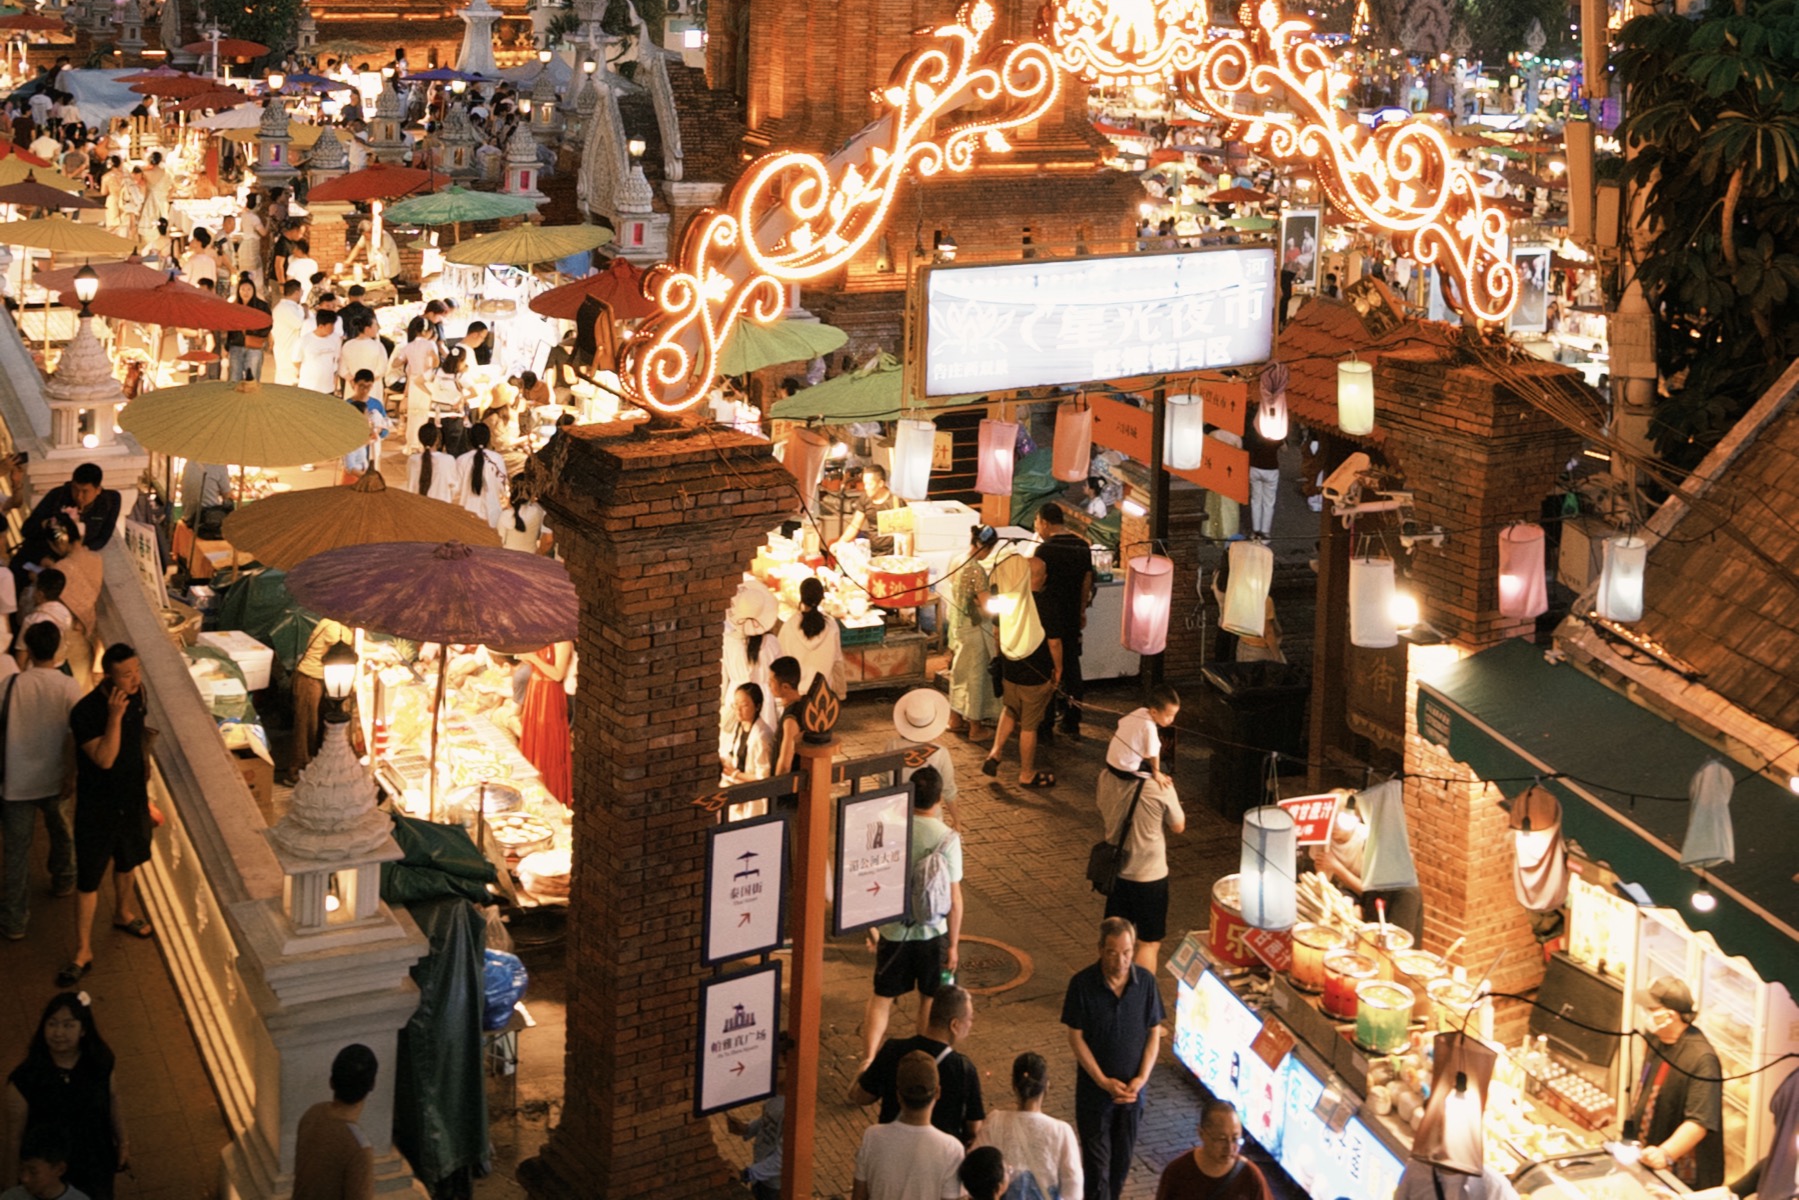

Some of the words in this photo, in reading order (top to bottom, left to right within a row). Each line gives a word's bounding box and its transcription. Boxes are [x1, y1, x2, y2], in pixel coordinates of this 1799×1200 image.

[1055, 279, 1267, 349] 星光夜市
[871, 578, 907, 600] 冰沙
[730, 882, 763, 899] 泰国街
[1254, 930, 1292, 968] 甘蔗汁
